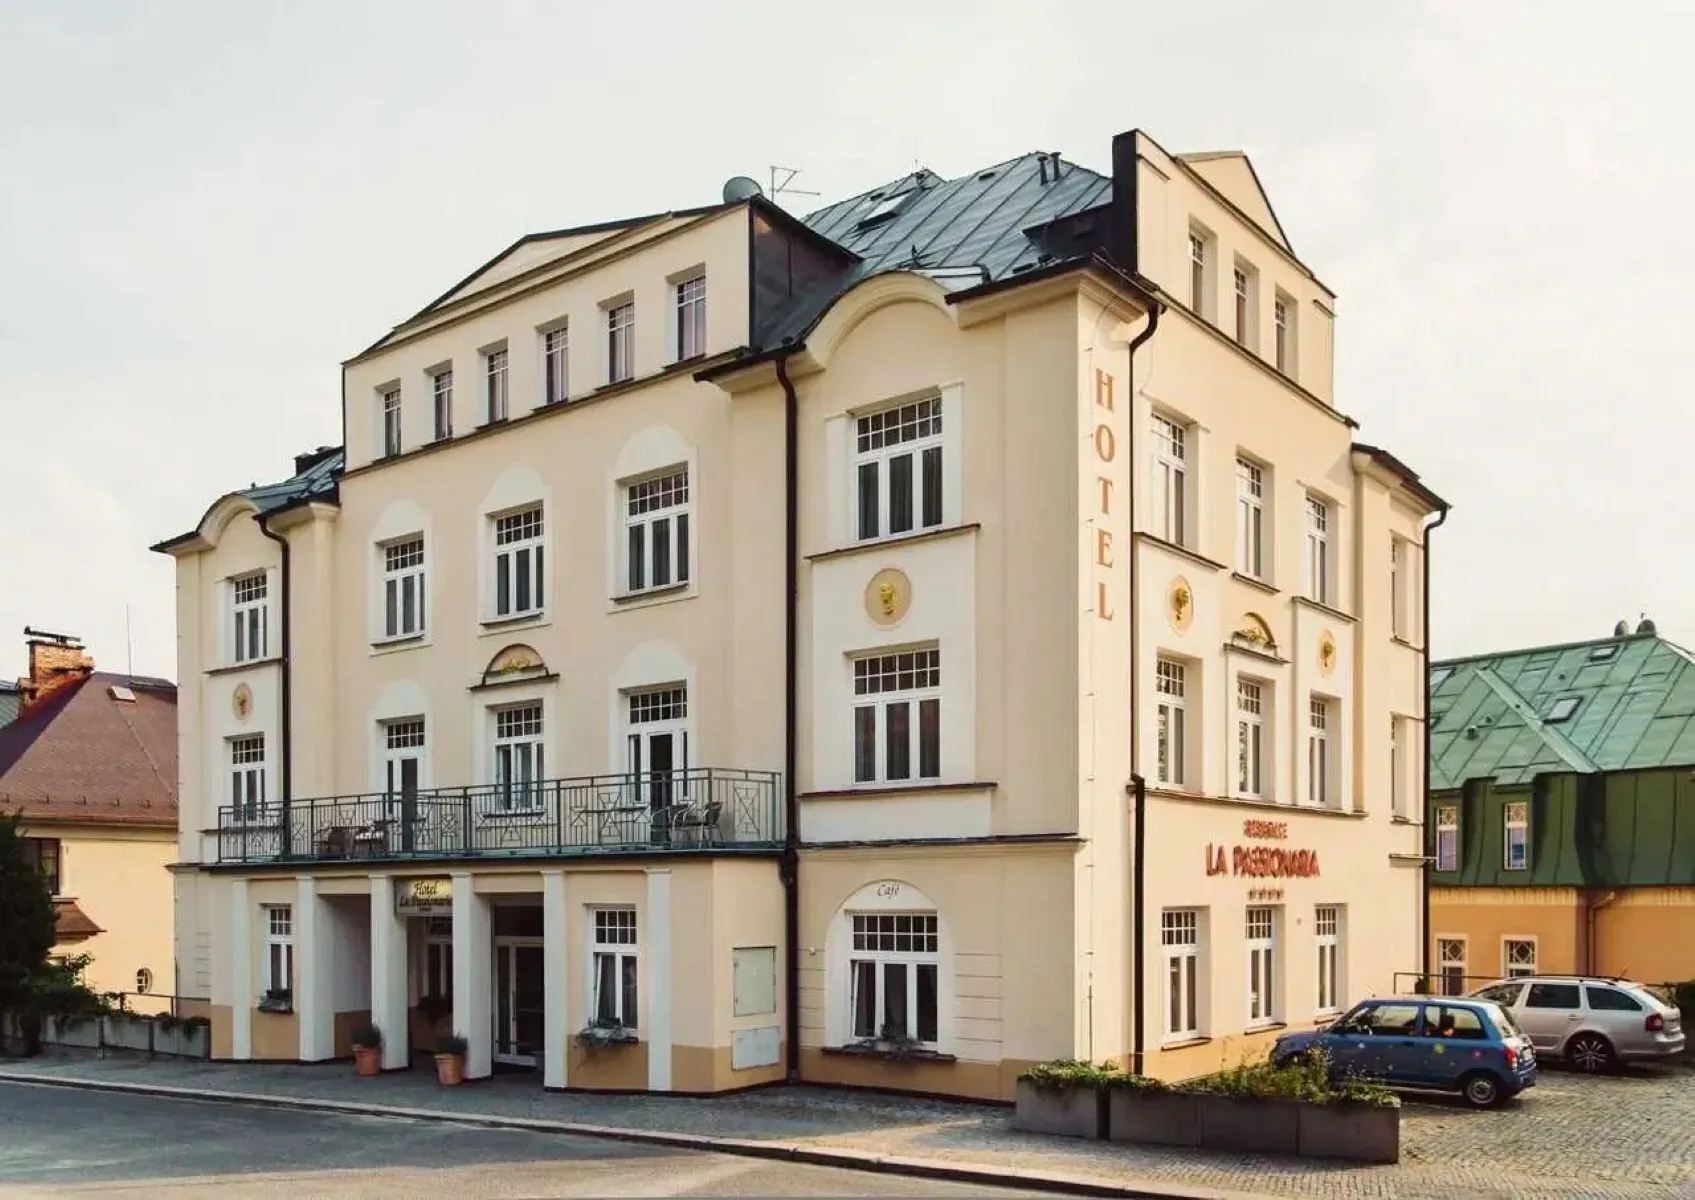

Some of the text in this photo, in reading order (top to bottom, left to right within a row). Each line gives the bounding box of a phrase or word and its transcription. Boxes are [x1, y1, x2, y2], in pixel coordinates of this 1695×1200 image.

[1095, 368, 1116, 622] HOTEL
[1206, 842, 1228, 877] LA
[413, 880, 439, 896] Hotel
